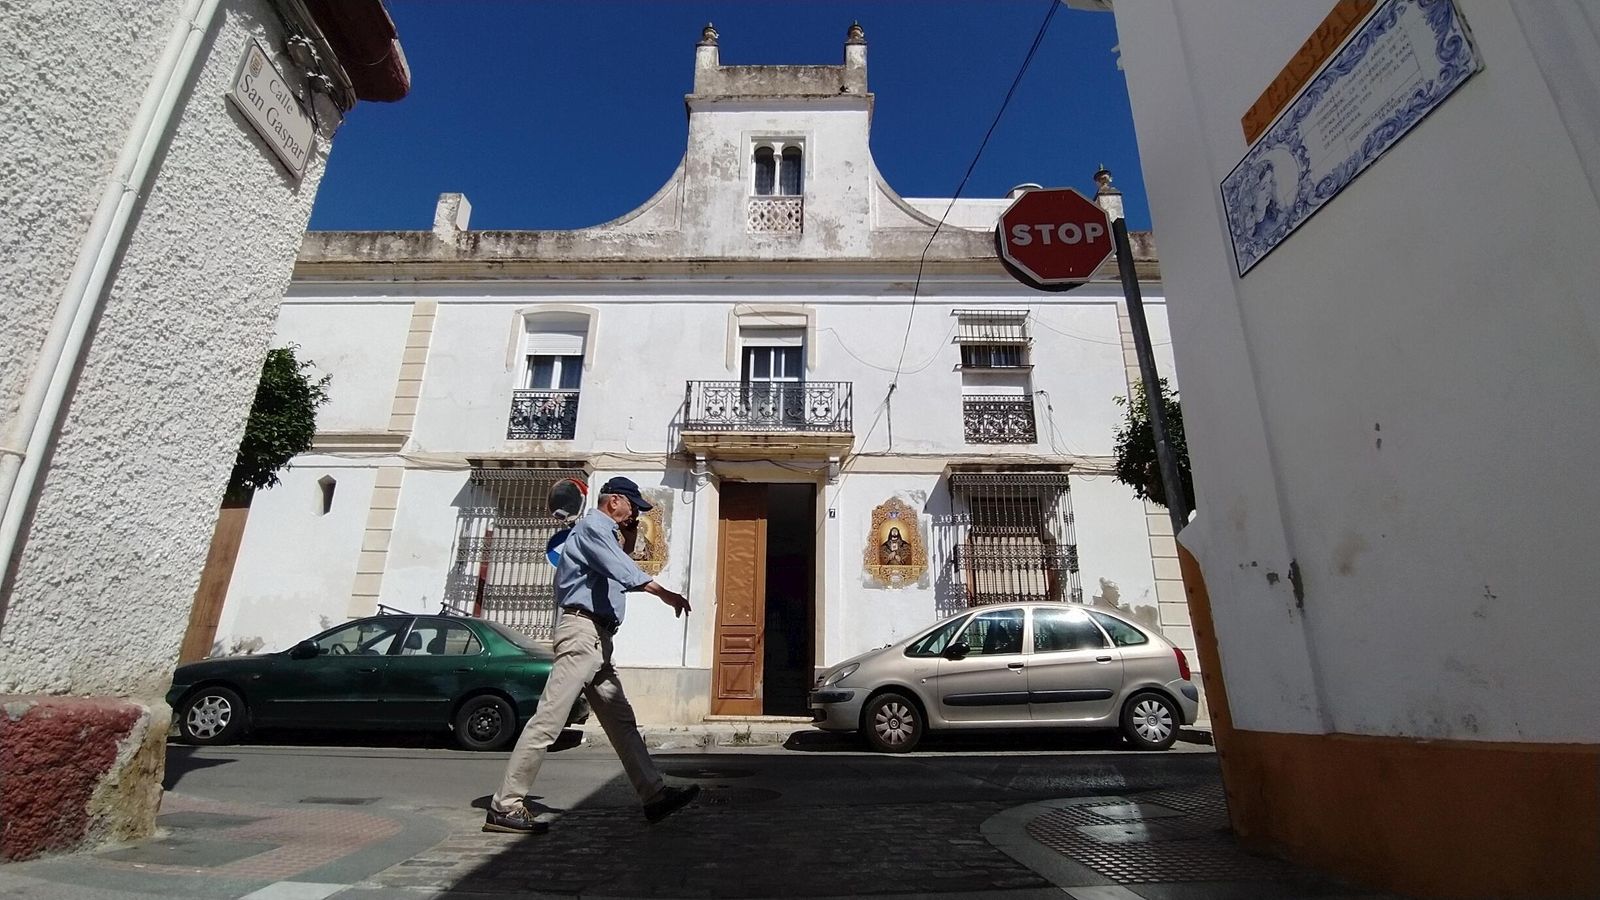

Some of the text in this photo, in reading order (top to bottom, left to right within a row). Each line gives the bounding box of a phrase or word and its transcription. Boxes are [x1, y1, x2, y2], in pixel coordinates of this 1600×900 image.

[269, 79, 294, 115] Calle
[240, 74, 304, 160] San Gaspar
[1011, 222, 1104, 246] STOP
